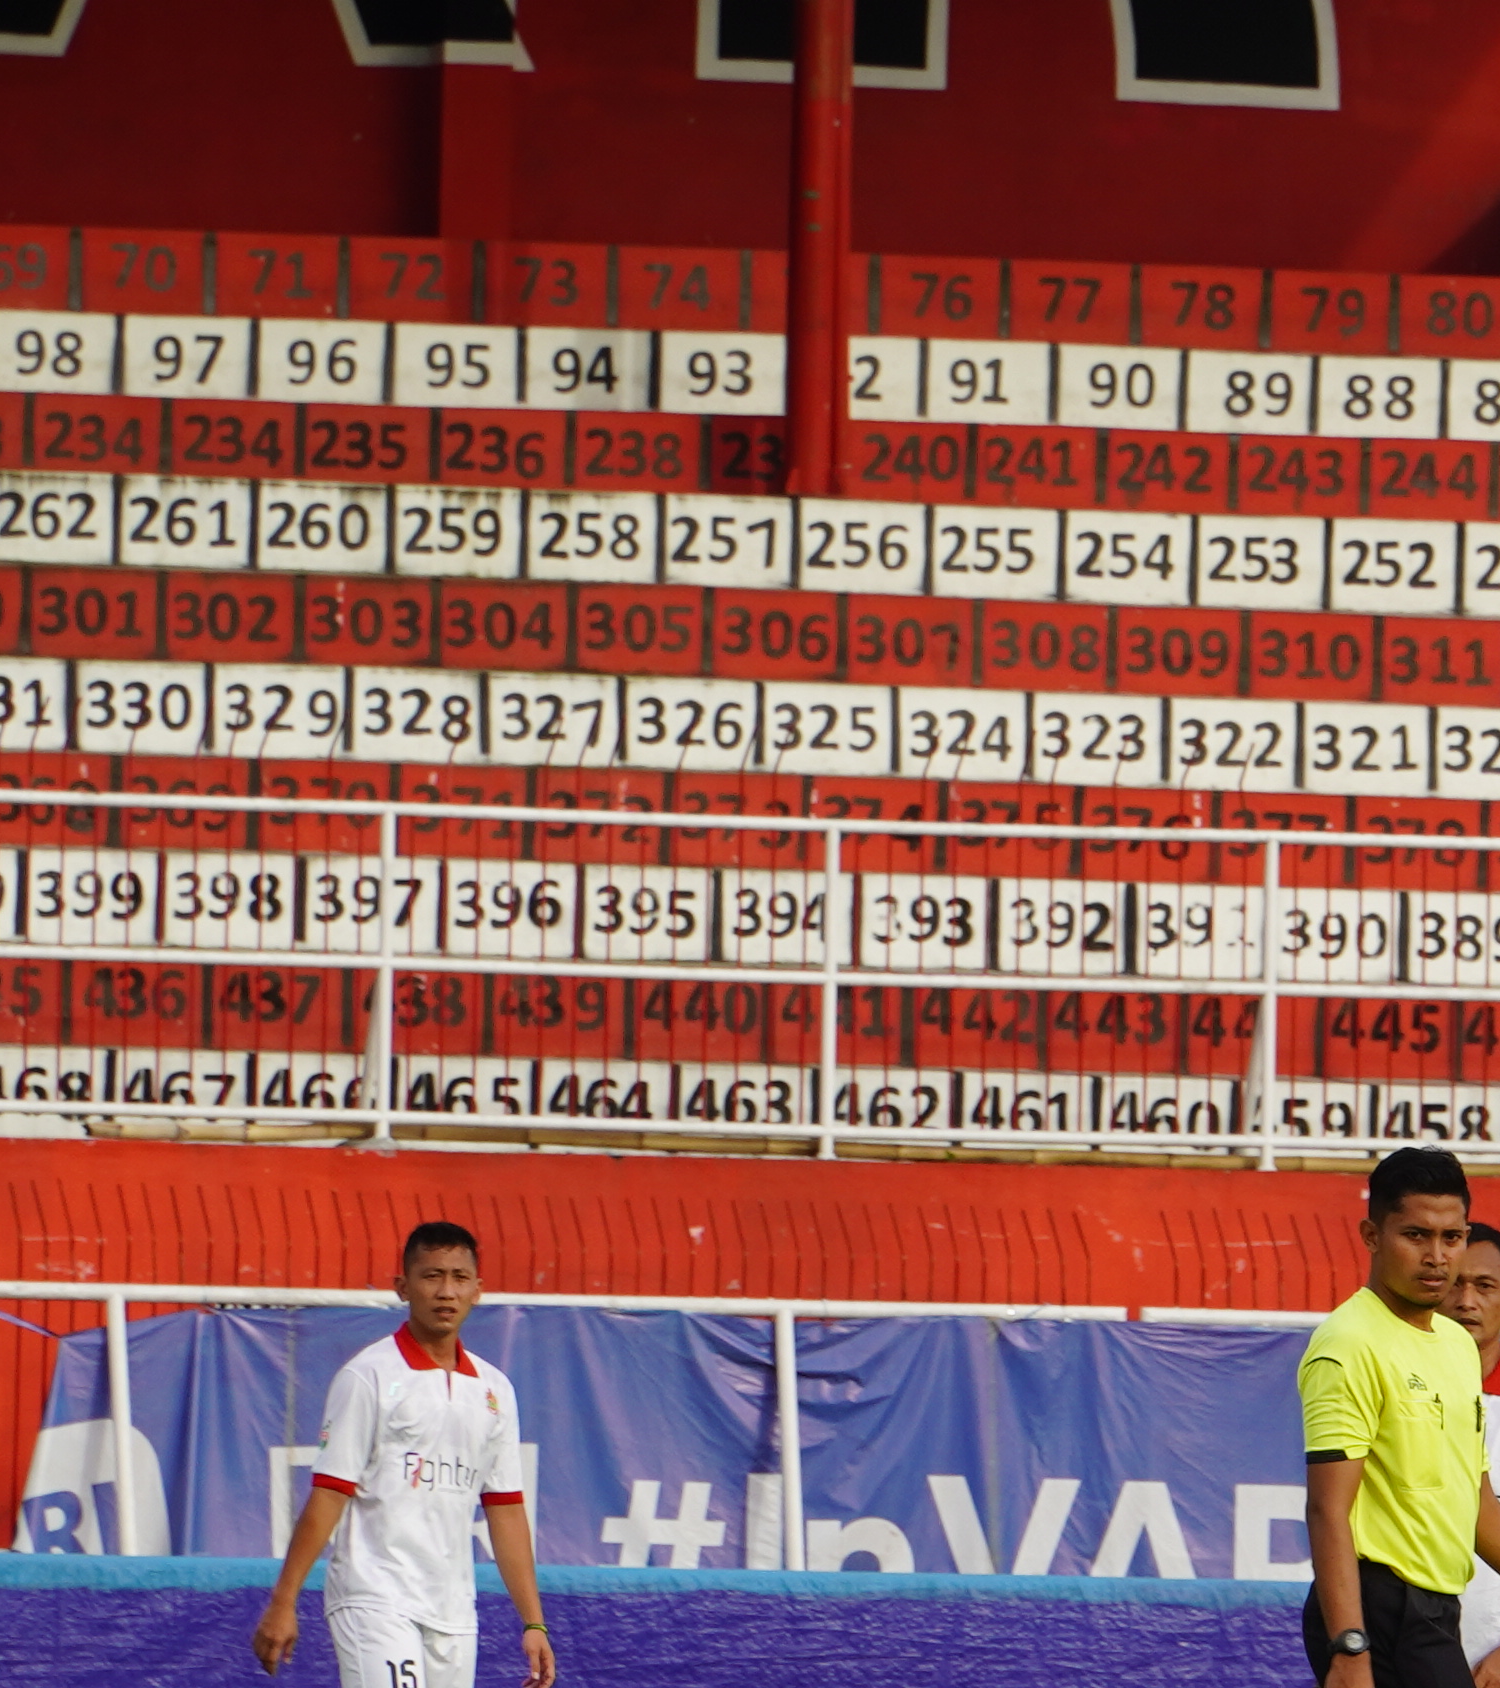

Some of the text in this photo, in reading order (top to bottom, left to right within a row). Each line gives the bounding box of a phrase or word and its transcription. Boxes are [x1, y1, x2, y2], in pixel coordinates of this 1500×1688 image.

[513, 255, 578, 306] 73
[912, 273, 972, 320] 76
[1040, 277, 1101, 323] 77
[1172, 282, 1234, 330] 78
[16, 330, 82, 377] 98
[153, 335, 223, 383] 97
[288, 339, 355, 384] 96
[426, 343, 489, 388] 95
[553, 346, 617, 392] 94
[688, 350, 751, 395] 93
[950, 359, 1007, 403] 91
[1089, 363, 1154, 407] 90
[1224, 370, 1292, 417] 89
[1343, 375, 1414, 420] 88
[311, 420, 406, 469] 235
[862, 434, 960, 482] 240
[1381, 450, 1477, 499] 244
[130, 496, 234, 546] 261
[267, 502, 369, 550] 260
[404, 507, 500, 556] 259
[540, 512, 638, 560] 258
[807, 521, 907, 569] 256
[942, 525, 1033, 573] 255
[1076, 531, 1172, 580] 254
[1209, 536, 1298, 584] 253
[1343, 540, 1435, 588] 252
[39, 586, 141, 637] 301
[175, 592, 277, 641] 302
[722, 607, 829, 661] 306
[1127, 627, 1229, 677] 309
[1390, 636, 1491, 686] 311
[87, 680, 191, 731] 330
[225, 683, 337, 737] 329
[364, 687, 470, 744] 328
[503, 693, 602, 747] 327
[638, 697, 741, 749] 326
[774, 703, 876, 752] 325
[911, 710, 1011, 761] 324
[1042, 711, 1144, 761] 323
[1180, 719, 1281, 767] 322
[1313, 724, 1417, 771] 321
[37, 871, 143, 920] 399
[174, 872, 281, 921] 398
[455, 879, 561, 928] 396
[594, 884, 695, 938] 395
[1282, 908, 1387, 959] 390
